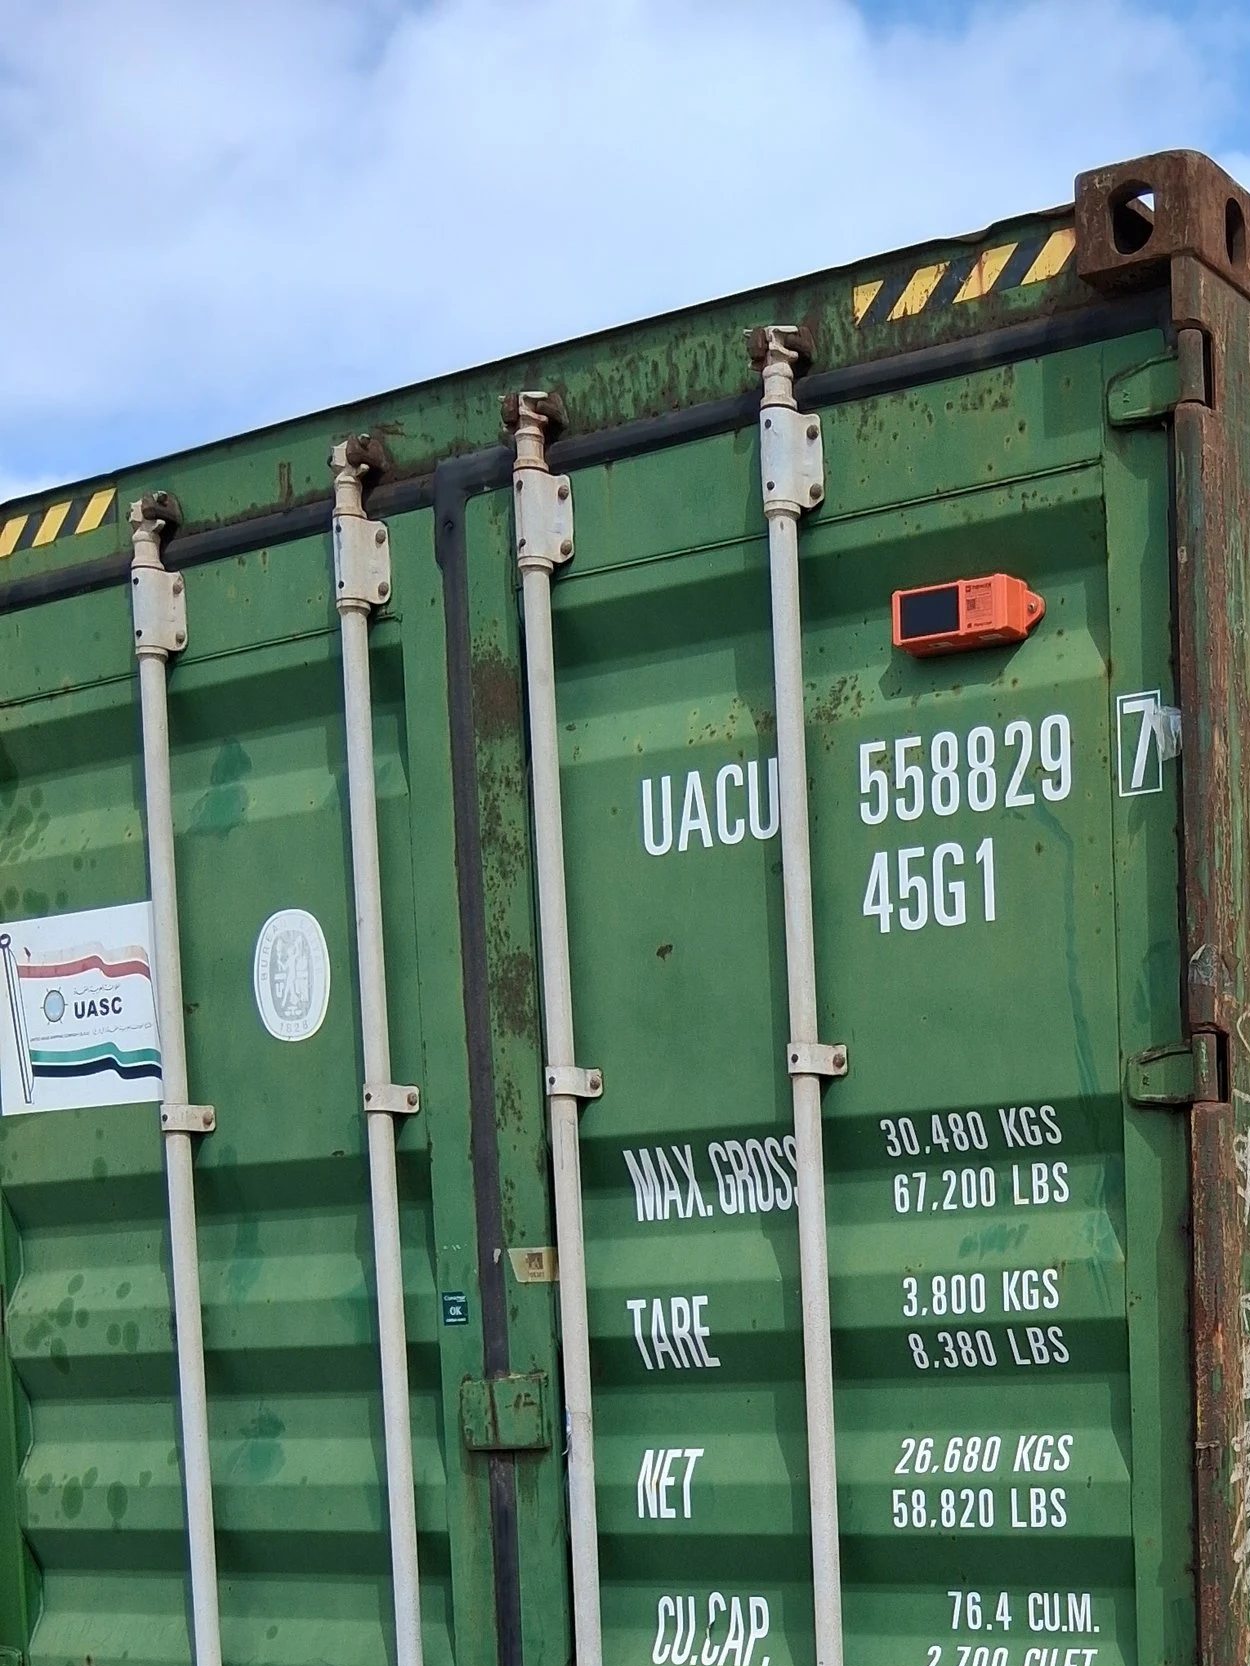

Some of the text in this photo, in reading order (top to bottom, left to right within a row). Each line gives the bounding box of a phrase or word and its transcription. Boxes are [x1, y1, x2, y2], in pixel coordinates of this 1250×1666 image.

[641, 697, 1156, 857] UACU 558829 7
[862, 837, 996, 934] 45G1
[73, 996, 123, 1020] UASC
[623, 1142, 714, 1222] MAX.
[879, 1111, 989, 1157] 30,480
[998, 1105, 1063, 1148] KGS
[893, 1161, 1070, 1213] 67,200 LBS
[449, 1306, 463, 1316] OK
[627, 1268, 1060, 1370] TARE 3,800 KGS
[1007, 1326, 1070, 1365] LBS
[637, 1434, 1074, 1519] NET 26,680 KGS
[892, 1487, 1067, 1528] 58,820 LBS
[652, 1590, 1100, 1666] CU.CAP. 76.4 CU.M.
